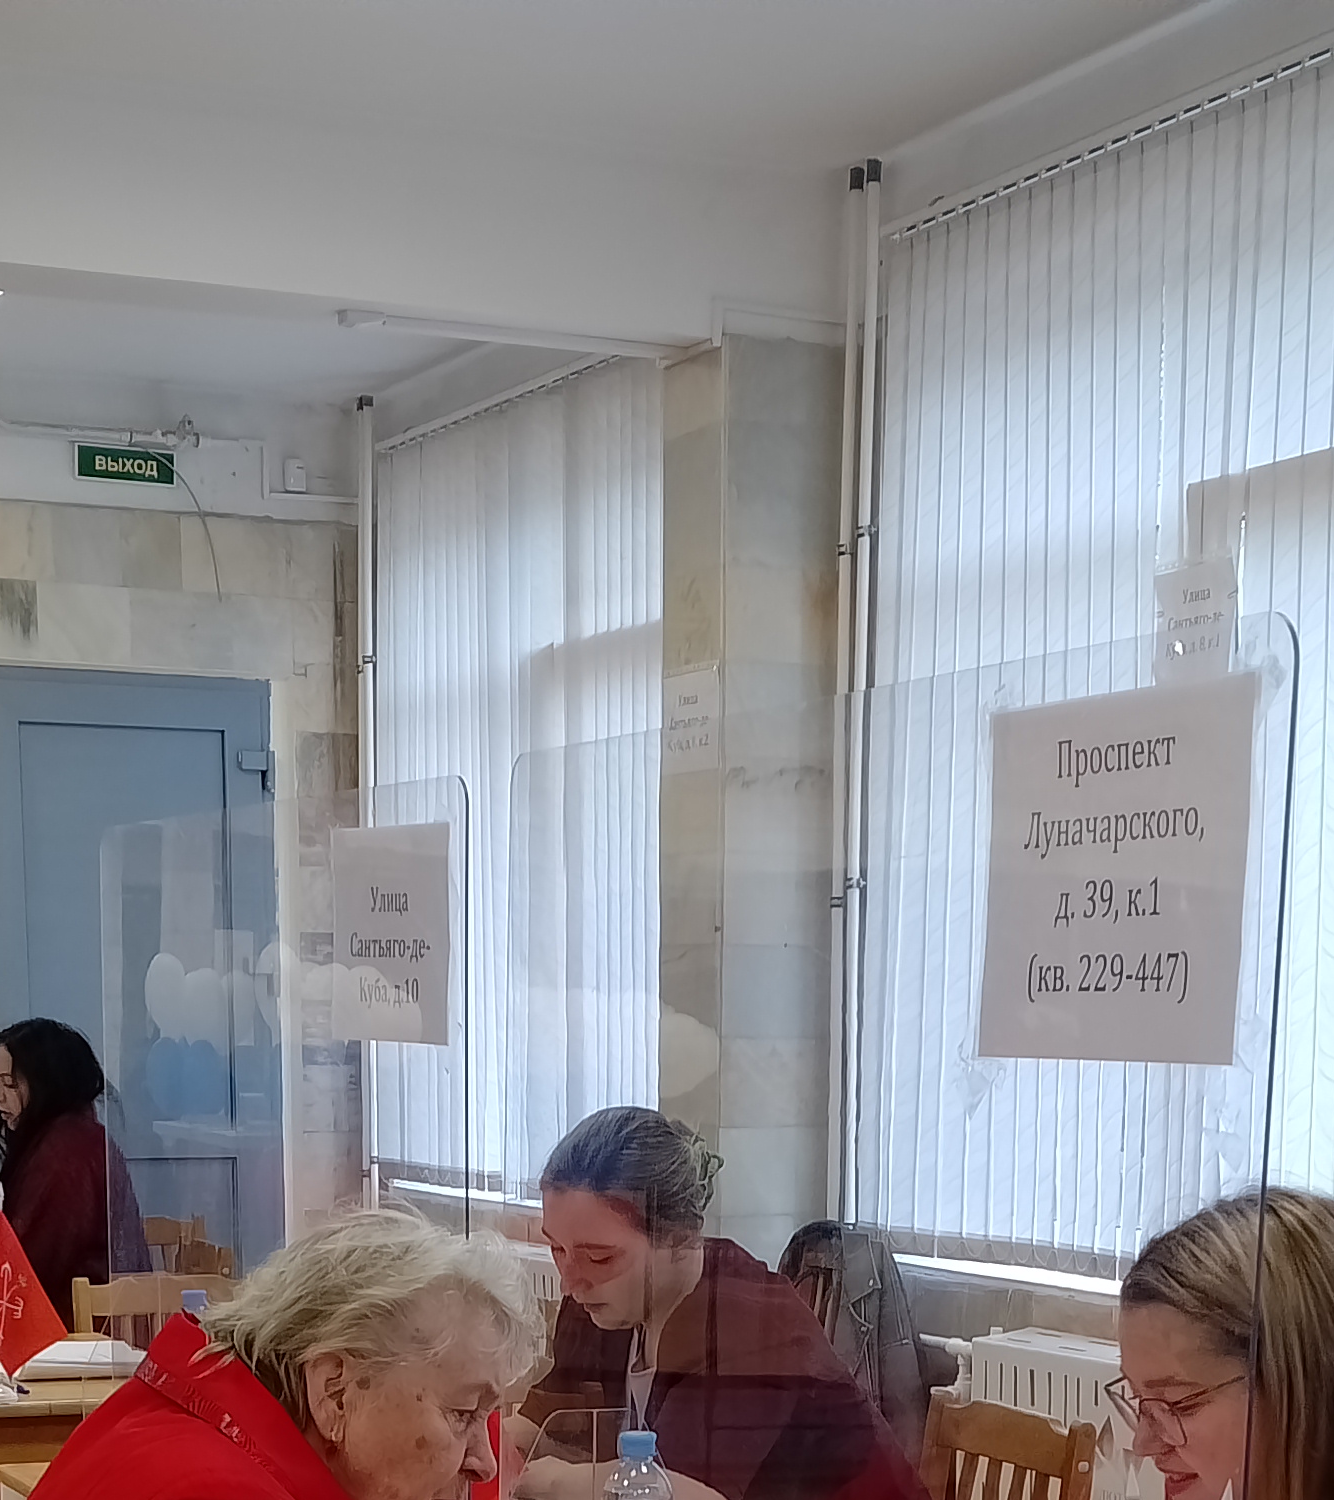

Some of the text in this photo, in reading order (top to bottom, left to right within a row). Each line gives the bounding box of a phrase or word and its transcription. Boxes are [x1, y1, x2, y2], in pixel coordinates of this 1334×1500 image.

[94, 455, 158, 479] ВЫХОД
[1182, 588, 1211, 604] Улица
[1057, 735, 1176, 788] Проспект
[1023, 806, 1205, 860] Луначарского,
[370, 886, 409, 916] Улица
[1053, 876, 1160, 928] д. 39, к.1
[350, 931, 431, 963] Сантьяго-де-
[359, 977, 391, 1008] Куба,
[1027, 950, 1190, 1004] (кв. 229-447)
